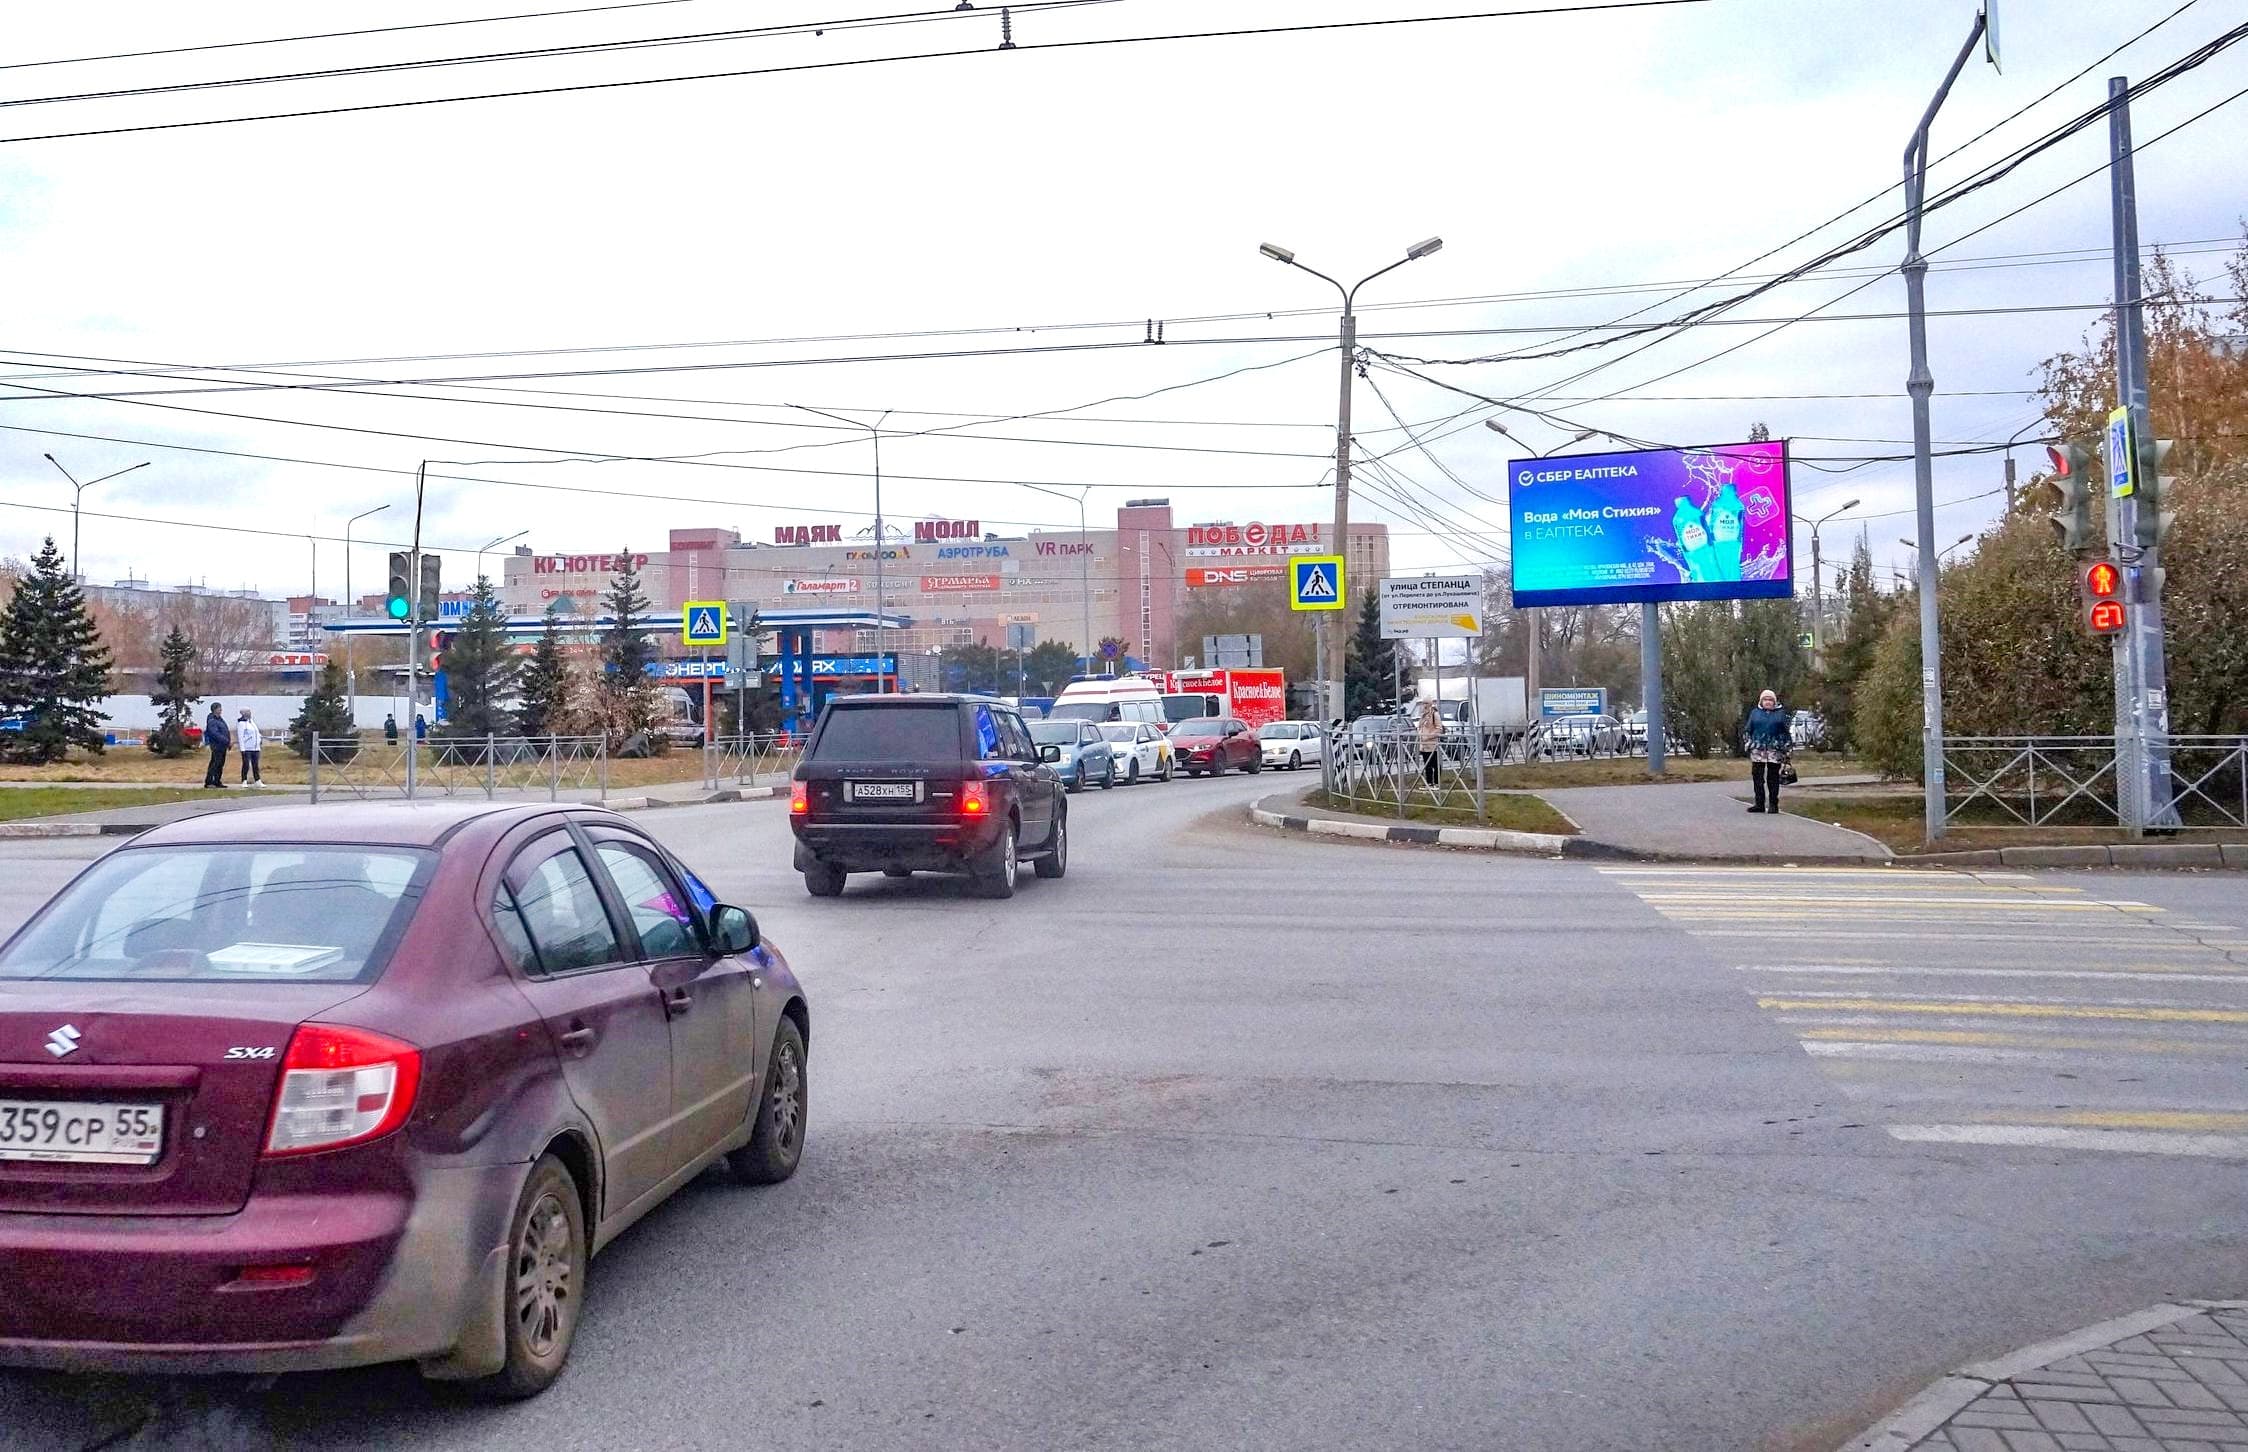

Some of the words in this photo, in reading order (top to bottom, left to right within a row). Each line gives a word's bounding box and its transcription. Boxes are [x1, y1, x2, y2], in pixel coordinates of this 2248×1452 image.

[1537, 470, 1572, 483] СБЕР
[1575, 466, 1638, 480] ЕАПТЕКА
[1524, 512, 1558, 523] Вода
[1562, 508, 1599, 521] «Моя
[1602, 506, 1662, 519] Стихия»
[775, 525, 842, 544] МАЯК
[914, 521, 980, 539] МОЛЛ
[1524, 531, 1532, 540] в
[1536, 525, 1604, 540] ЕАПТЕКА
[938, 546, 1010, 559] АЭРОТРУБА
[1036, 542, 1056, 556] VR
[1060, 543, 1094, 555] ПАРК
[1220, 546, 1289, 556] МАРКЕТ
[534, 554, 648, 574] КИНОТЕАР
[1204, 570, 1247, 583] DNS
[797, 581, 847, 592] Галамарт
[850, 580, 858, 590] 2
[1390, 583, 1418, 592] улица
[1420, 580, 1471, 590] СТЕПАНЦА
[1392, 601, 1469, 610] ОТРЕМОНТИРОВАНА
[2095, 605, 2122, 627] 27
[1170, 678, 1224, 691] Крсное&Белое
[224, 1046, 276, 1059] SX4
[116, 1108, 149, 1137] 55
